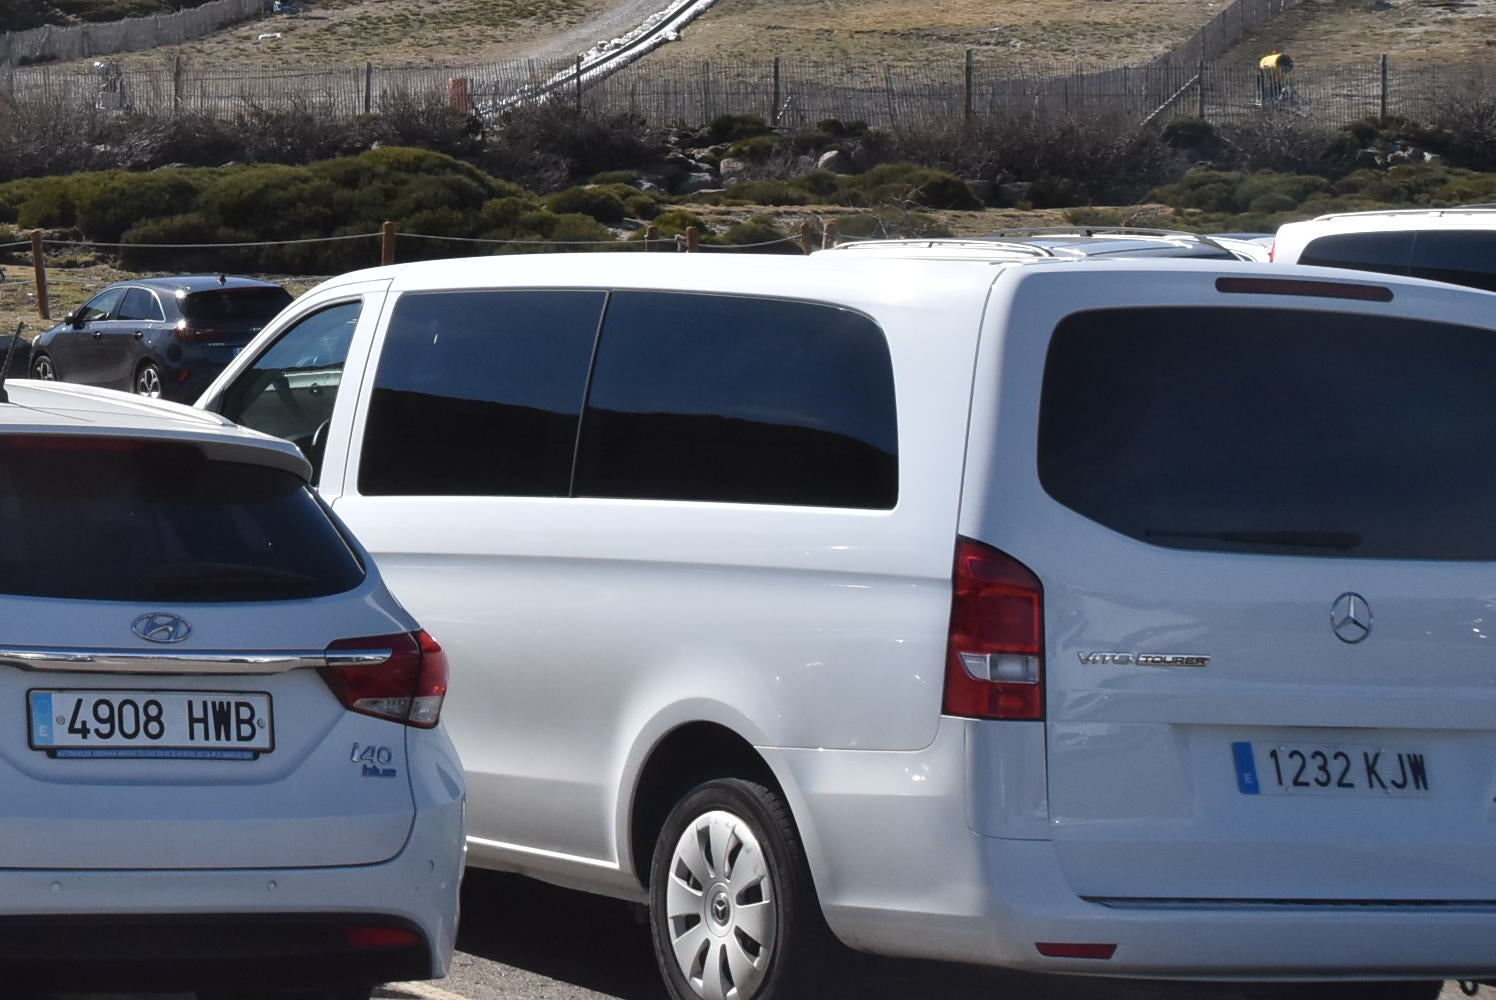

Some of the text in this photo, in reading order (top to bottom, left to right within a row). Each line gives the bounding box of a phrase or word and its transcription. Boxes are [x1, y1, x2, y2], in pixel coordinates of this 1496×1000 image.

[1141, 654, 1209, 665] TOURER
[67, 698, 257, 742] 4908 HWB
[351, 742, 392, 765] i40
[1270, 749, 1429, 791] 1232 KJW
